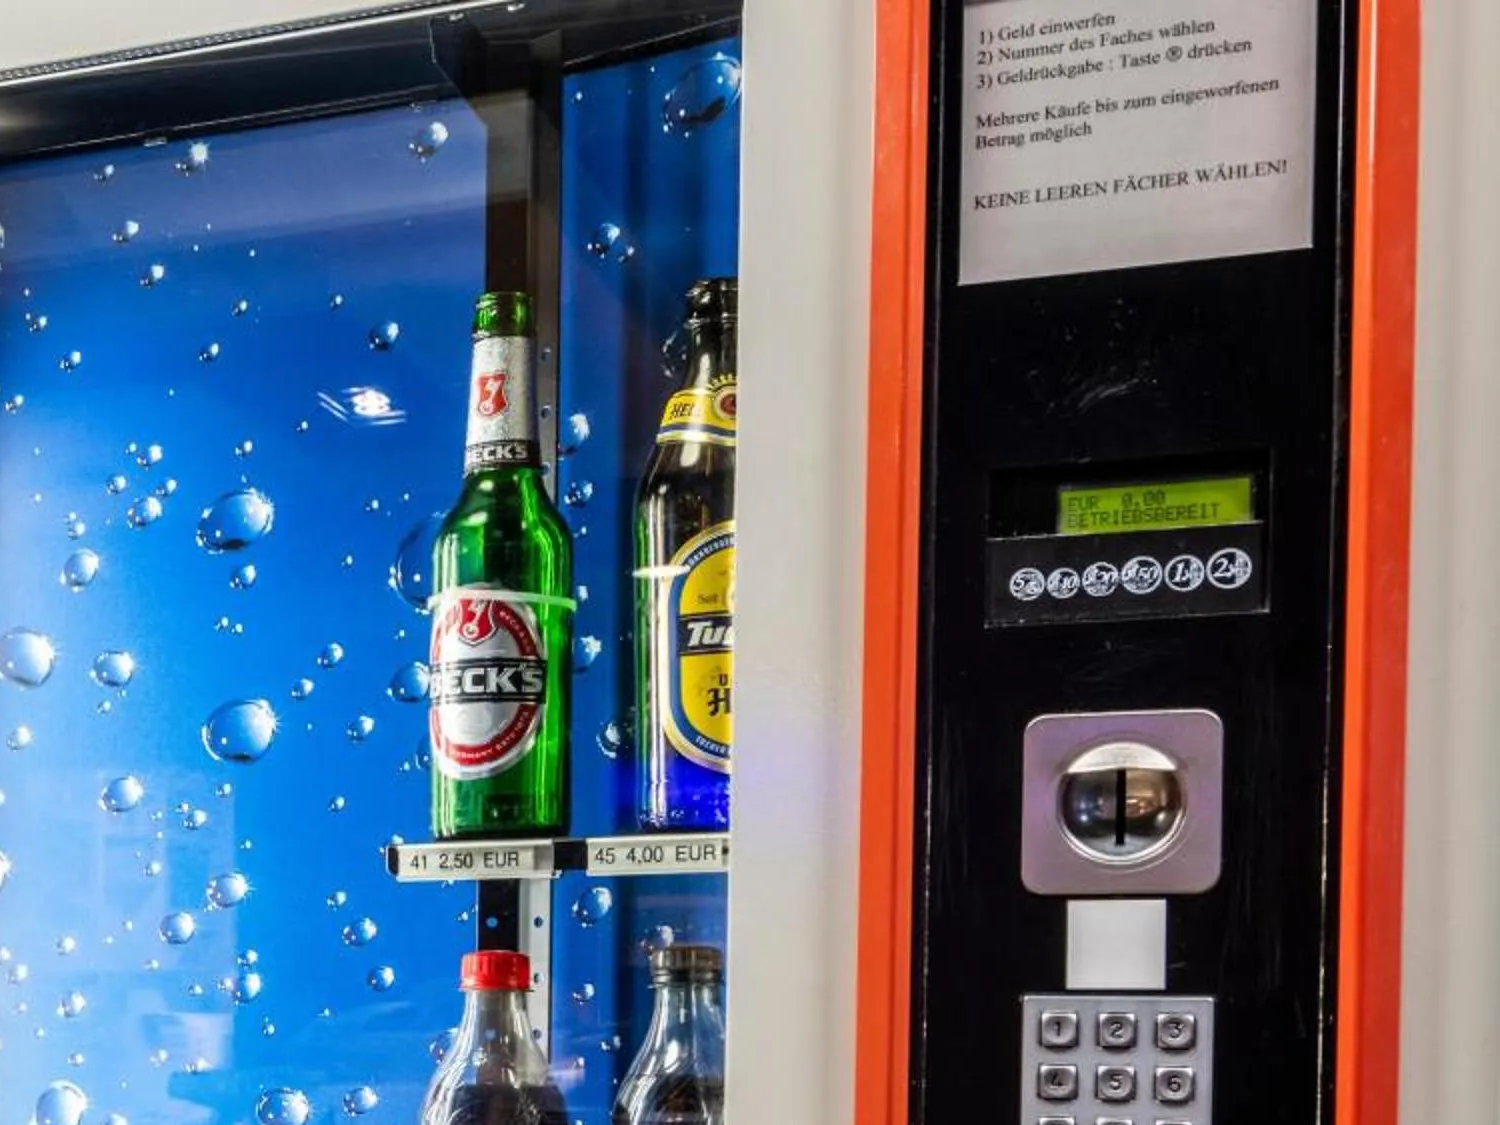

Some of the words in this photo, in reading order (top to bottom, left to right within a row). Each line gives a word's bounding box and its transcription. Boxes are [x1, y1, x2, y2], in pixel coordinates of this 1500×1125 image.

[997, 23, 1035, 42] Geld
[1039, 12, 1116, 35] einwerfen
[977, 50, 993, 66] 2)
[998, 41, 1065, 63] Nummer
[1069, 36, 1095, 54] des
[1099, 28, 1154, 50] Faches
[1158, 18, 1215, 40] wählen
[976, 74, 993, 90] 3)
[996, 57, 1104, 88] Geldrückgabe
[1120, 50, 1161, 70] Taste
[1187, 37, 1253, 61] drücken
[975, 108, 1040, 130] Mehrere
[1044, 100, 1091, 121] Käufe
[1095, 95, 1119, 114] bis
[1123, 94, 1157, 111] zum
[1160, 76, 1280, 108] eingeworfenen
[975, 130, 1026, 151] Betrag
[1029, 121, 1093, 145] möglich
[973, 190, 1031, 211] KEINE
[1034, 181, 1108, 204] LEEREN
[1112, 170, 1190, 194] FÄCHER
[1194, 158, 1288, 184] WÄHLEN!
[1067, 495, 1099, 511] EUR
[1067, 502, 1221, 528] BETRIEBSBEREIT
[410, 853, 428, 870] 41
[483, 852, 520, 869] EUR
[594, 847, 616, 864] 45
[675, 844, 717, 862] EUR
[1110, 1021, 1124, 1039] 2
[1170, 1022, 1185, 1039] 3
[1110, 1074, 1123, 1091] 5
[1168, 1076, 1181, 1093] 6
